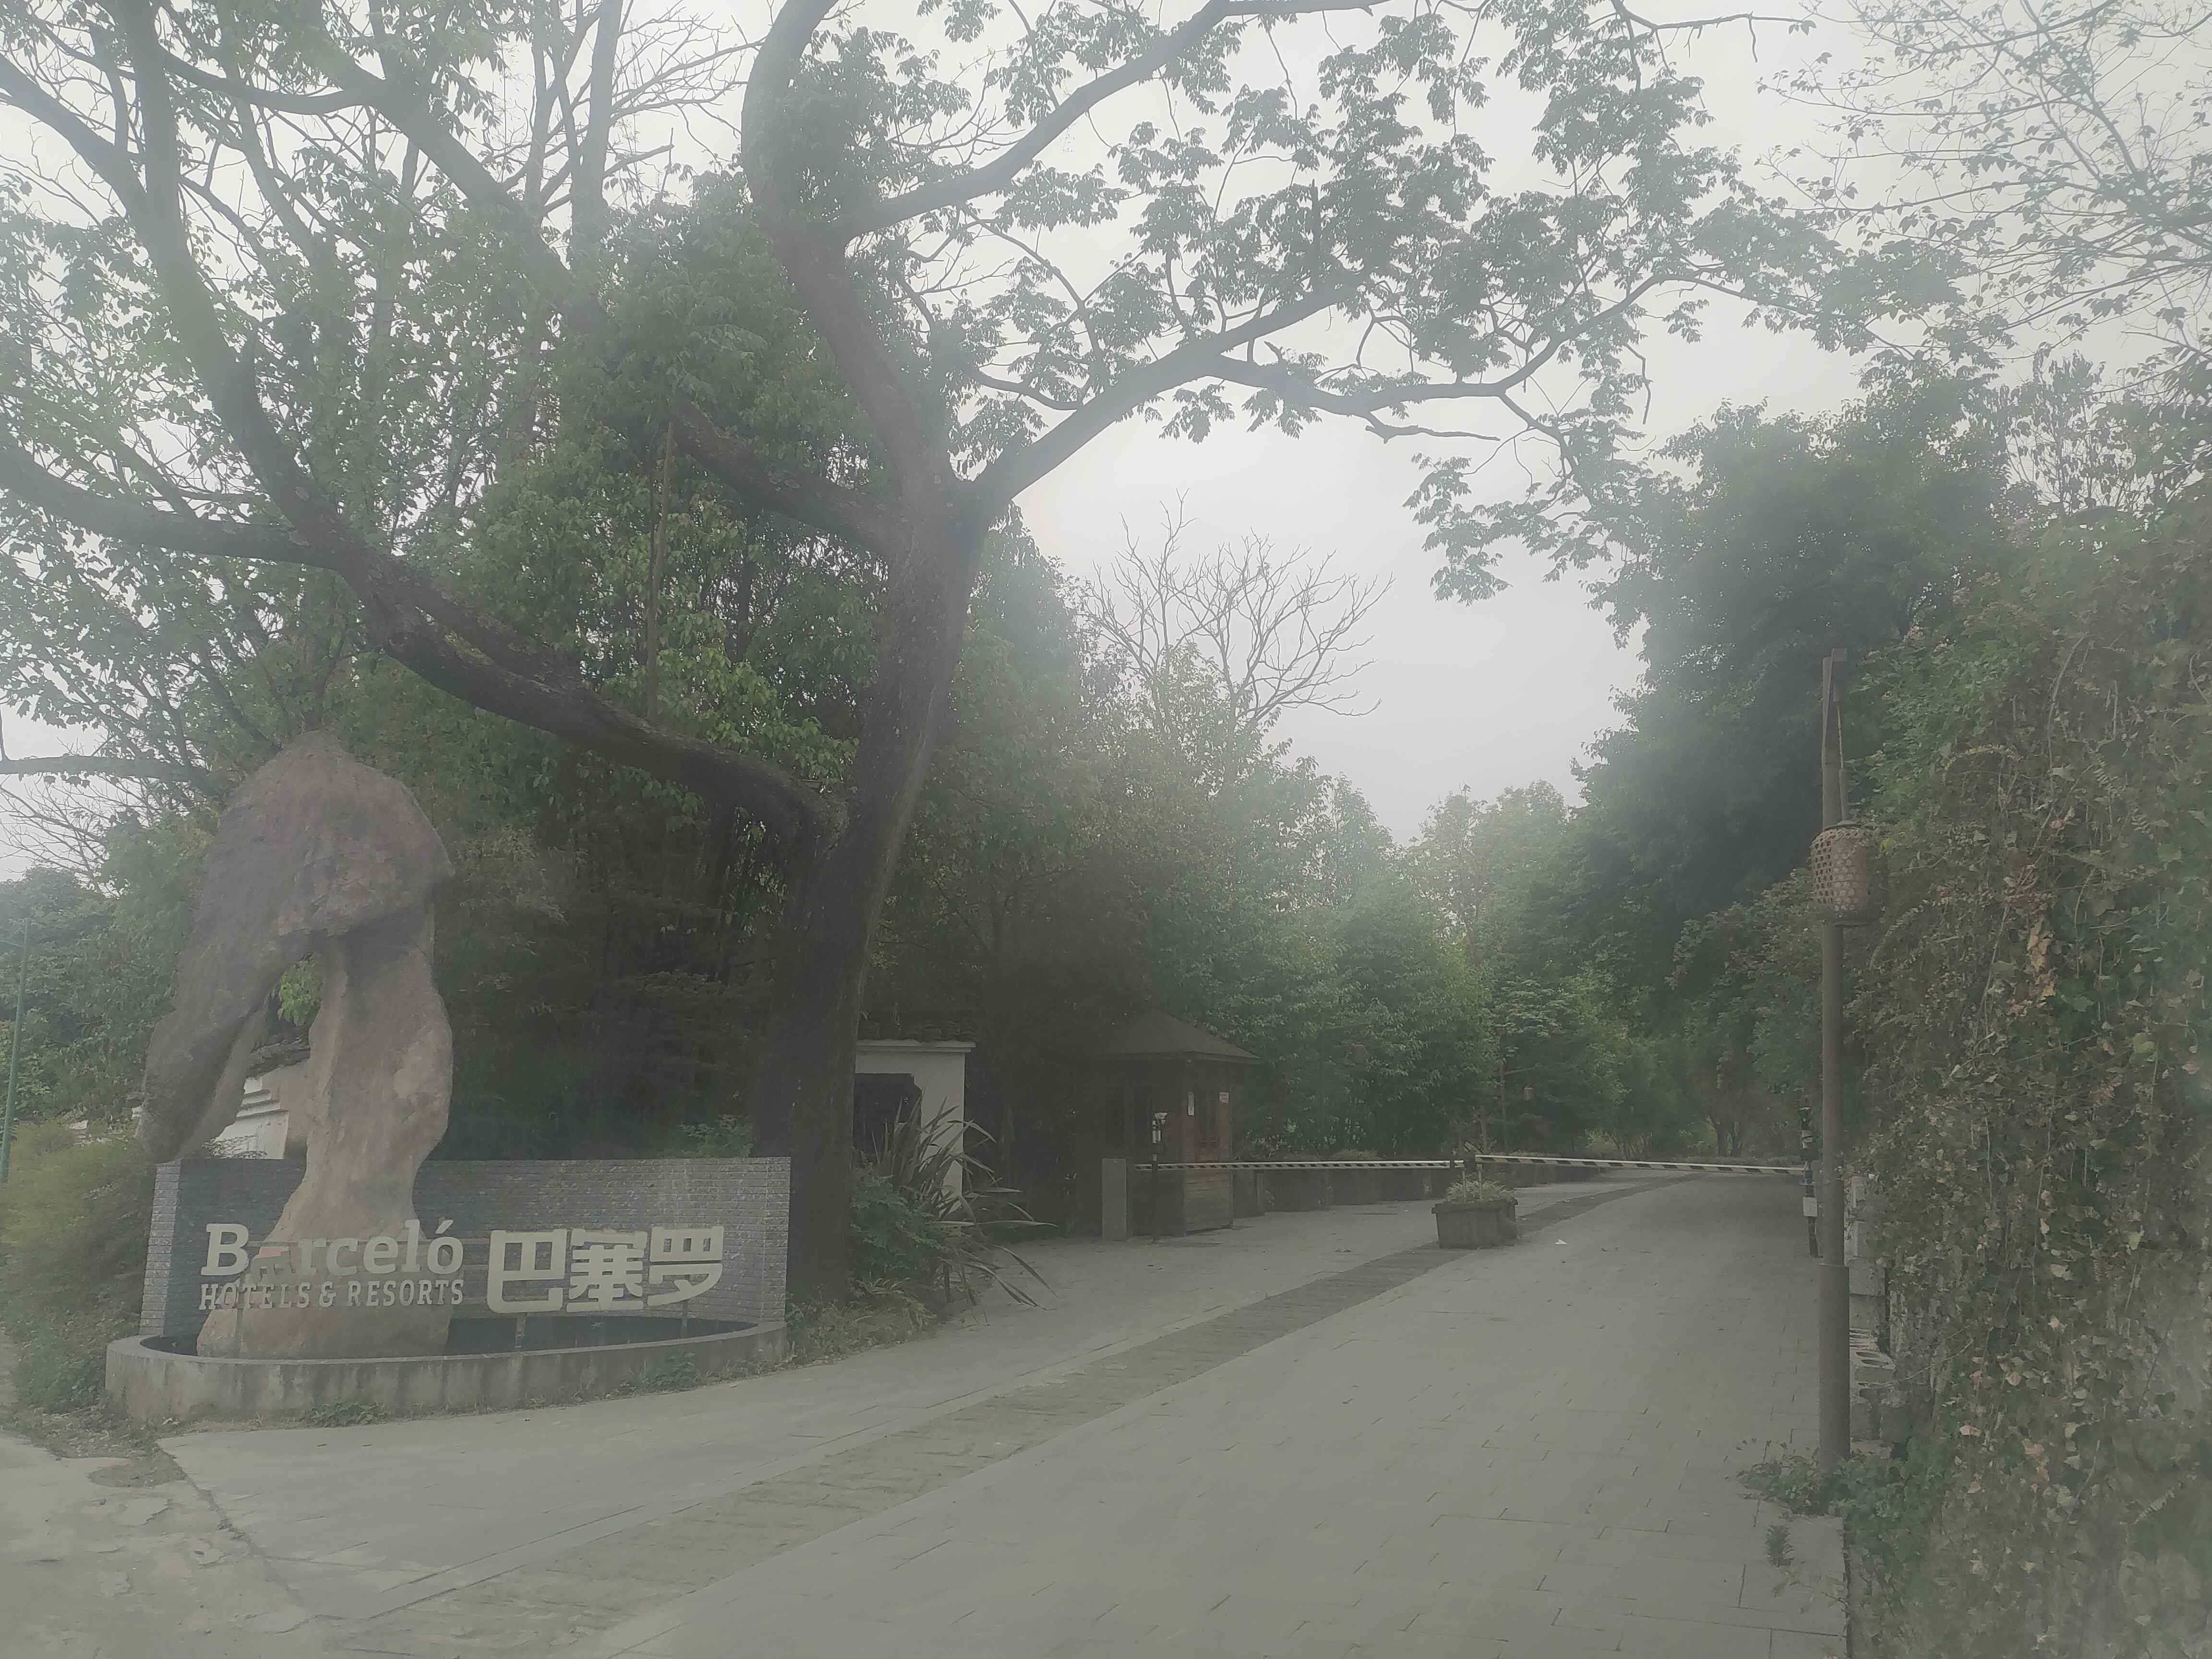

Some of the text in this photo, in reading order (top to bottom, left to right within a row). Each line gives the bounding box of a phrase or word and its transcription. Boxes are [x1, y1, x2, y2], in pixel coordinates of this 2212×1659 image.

[199, 1279, 464, 1310] HOTELS & RESORTS
[487, 1226, 724, 1313] 巴塞罗
